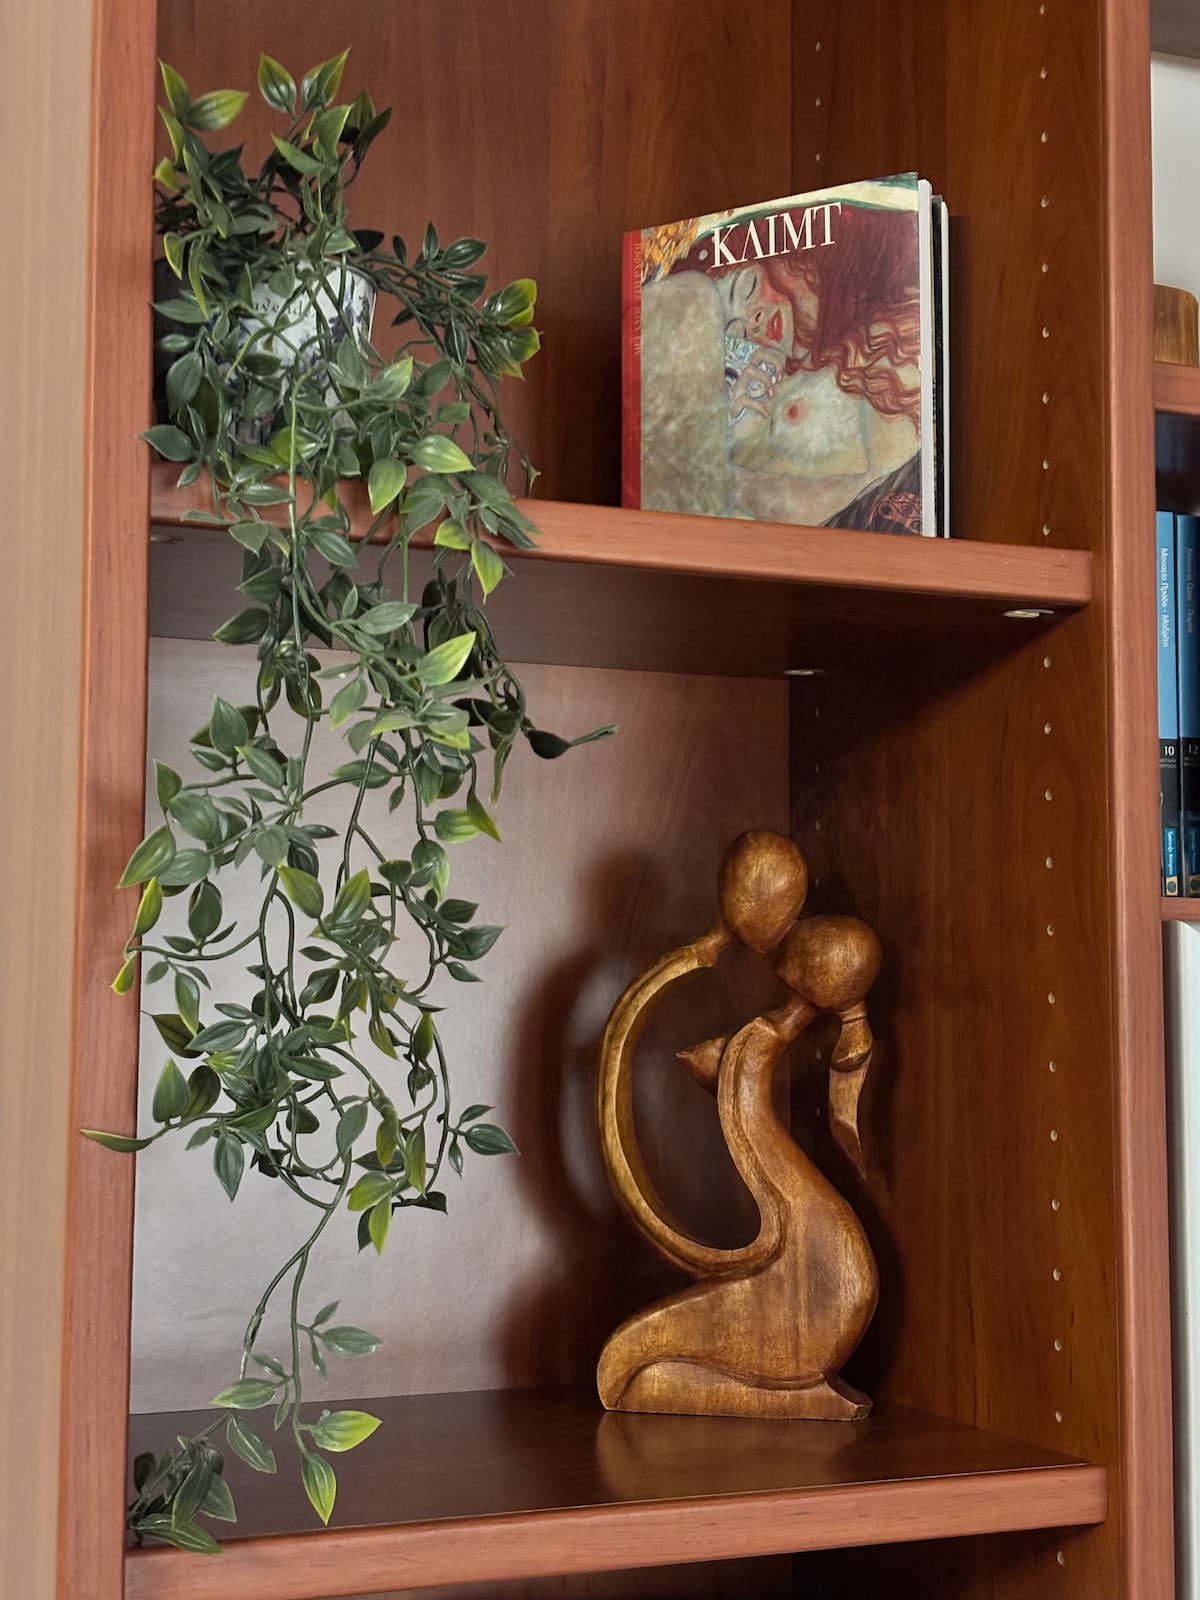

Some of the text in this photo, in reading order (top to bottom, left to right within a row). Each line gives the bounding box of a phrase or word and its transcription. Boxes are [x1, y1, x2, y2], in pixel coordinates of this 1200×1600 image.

[711, 202, 842, 268] ΚΛΙΜΤ
[1160, 548, 1168, 580] Μουσείο
[1160, 582, 1169, 608] Πράδο
[1161, 614, 1170, 648] Μαδρίτη
[1164, 745, 1175, 757] 10
[1188, 743, 1199, 755] 12
